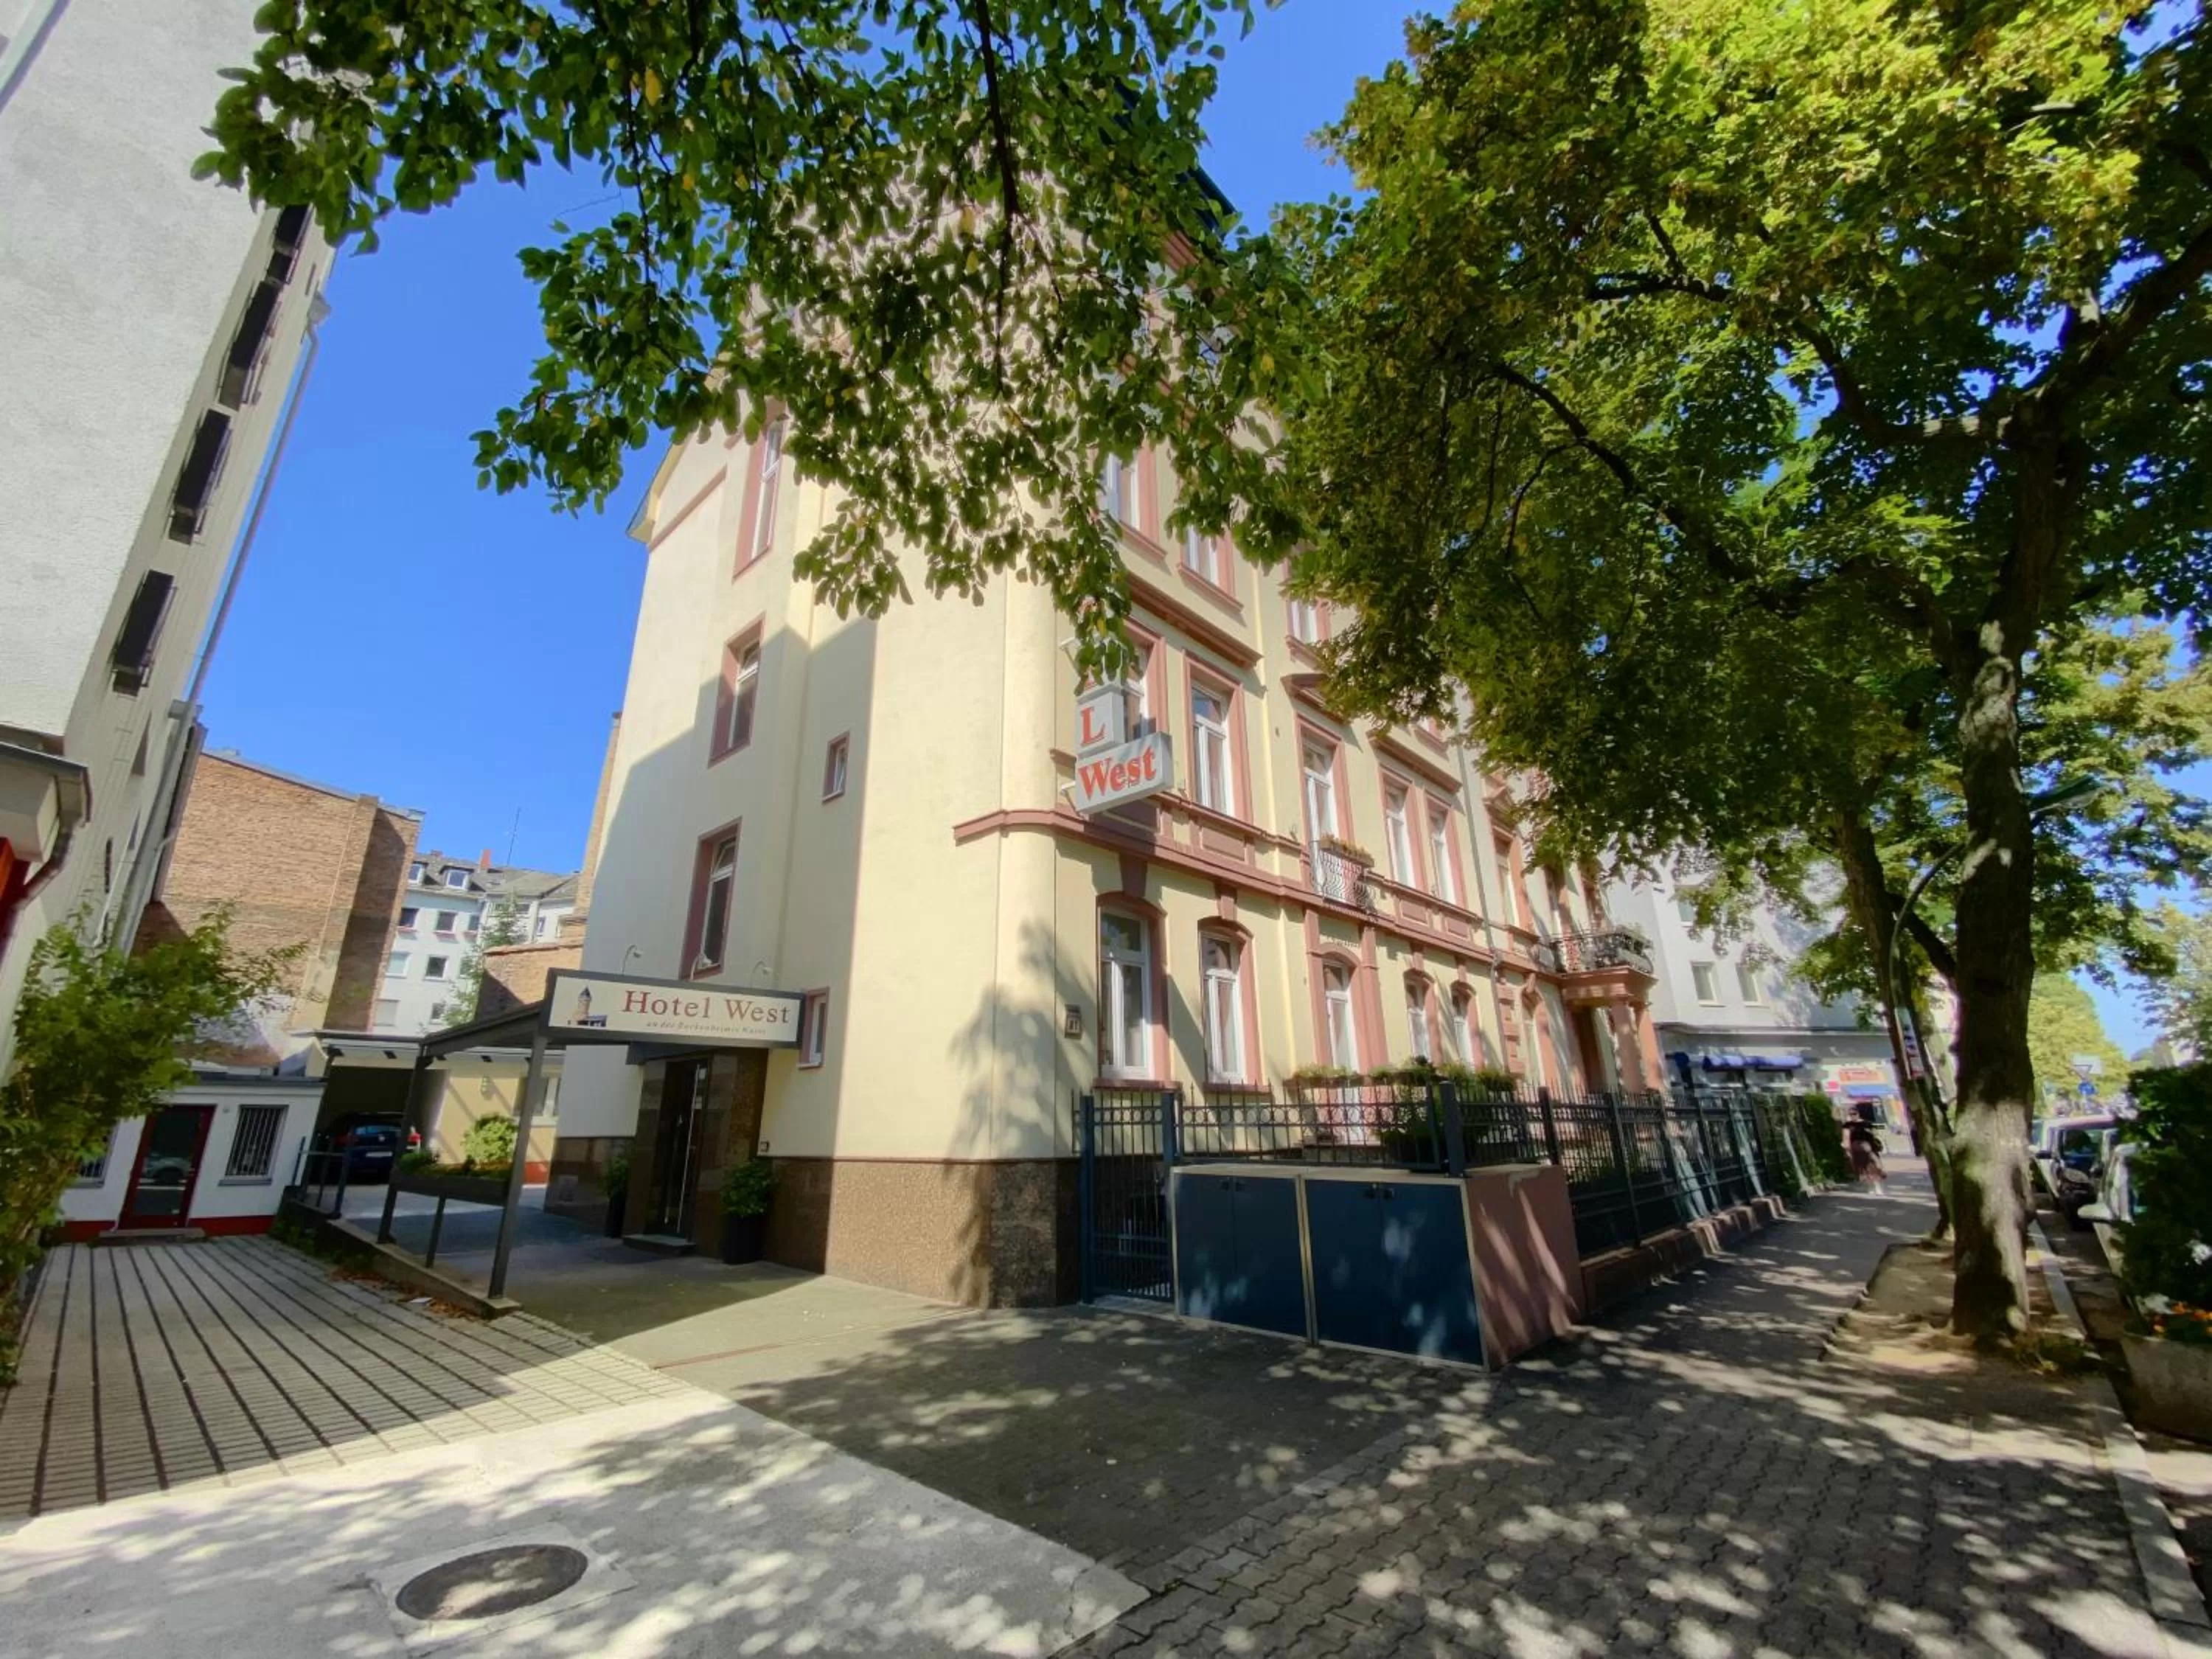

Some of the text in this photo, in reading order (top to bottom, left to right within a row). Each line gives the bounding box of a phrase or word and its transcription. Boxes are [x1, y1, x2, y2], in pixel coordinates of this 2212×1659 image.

[1077, 745, 1157, 801] West
[622, 990, 791, 1024] Hotel West
